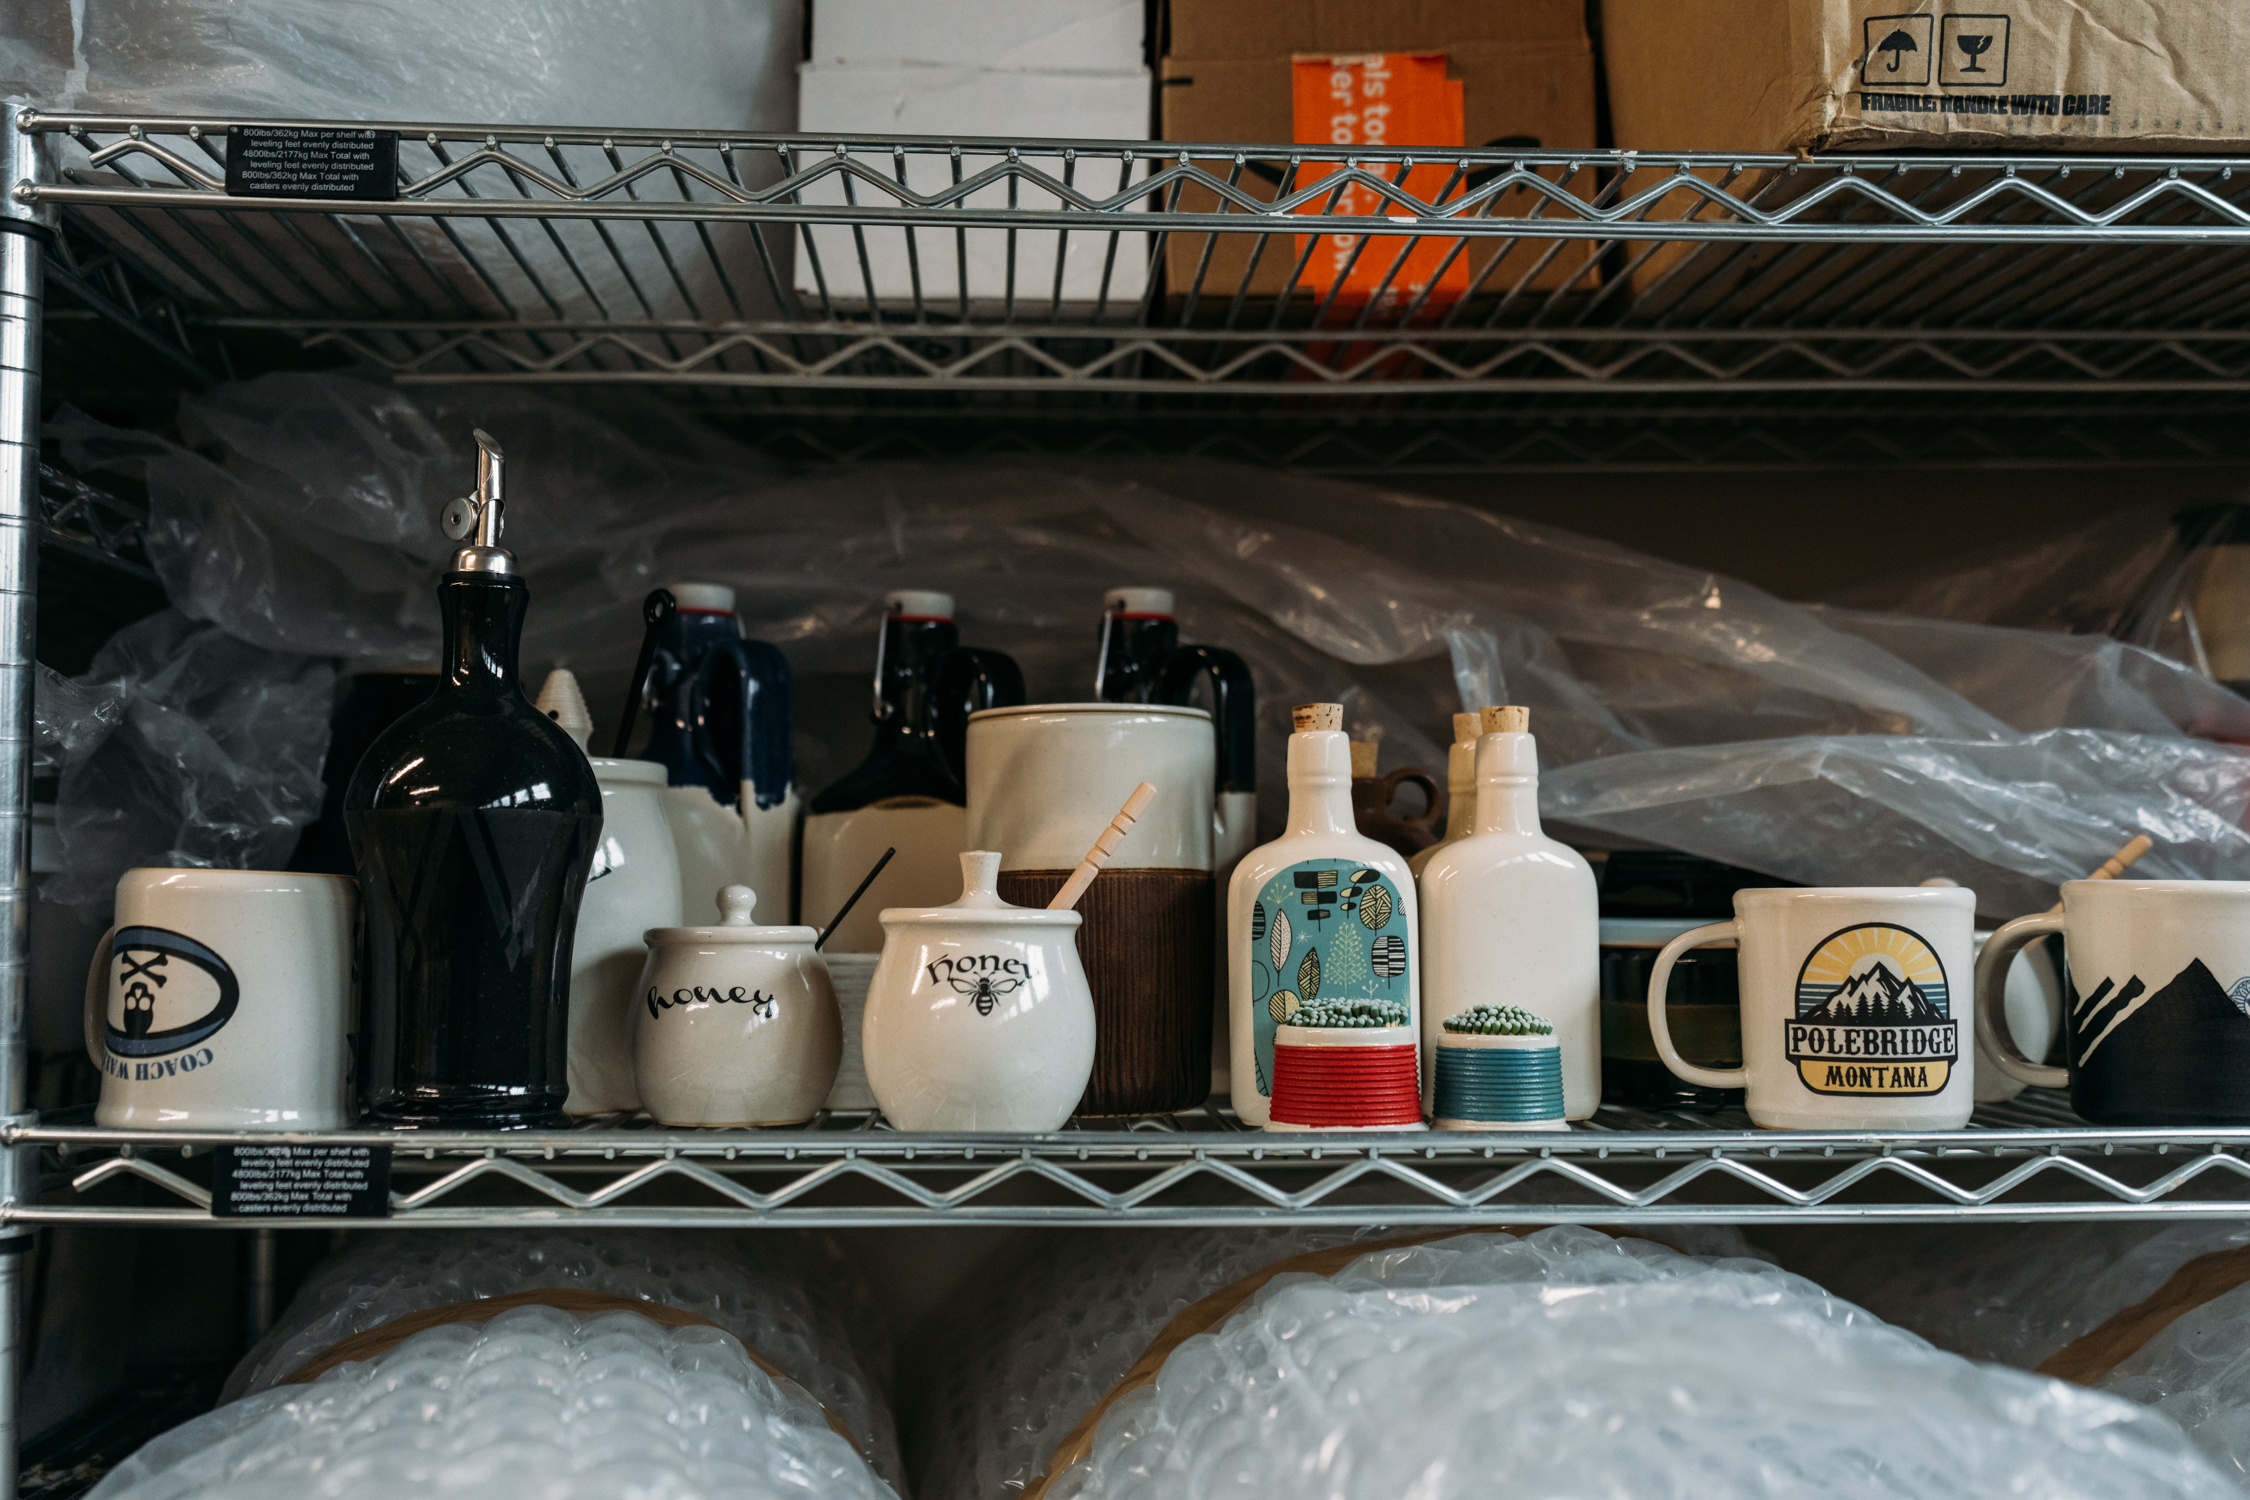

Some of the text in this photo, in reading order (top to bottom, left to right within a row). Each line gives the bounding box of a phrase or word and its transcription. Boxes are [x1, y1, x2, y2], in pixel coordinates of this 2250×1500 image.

[2011, 95, 2060, 115] WITH
[2062, 94, 2112, 116] CARE
[244, 128, 298, 138] 800lbs/362kg
[301, 130, 318, 138] Max
[251, 140, 374, 150] leveling feet evenly distributed
[243, 150, 308, 160] 4800lbs/2177kg
[353, 152, 370, 160] with
[250, 161, 374, 170] leveling feet evenly distributed
[242, 171, 359, 181] 800lbs/362kg Max Total with
[250, 182, 354, 192] casters evenly distributed
[648, 985, 774, 1019] honey
[1791, 1026, 1954, 1056] POLEBRIDGE
[135, 1047, 214, 1081] COACH
[1824, 1065, 1929, 1089] MONTANA
[293, 1148, 311, 1156] Max
[313, 1149, 328, 1158] per
[330, 1147, 351, 1156] shelf
[352, 1148, 370, 1156] with
[241, 1158, 370, 1169] leveling feet evenly distributed
[232, 1169, 364, 1180] 4800lbs/2177kg Max Total with
[240, 1181, 368, 1191] leveling feet evenly distributed
[231, 1192, 352, 1202] 800lbs/362kg Max Total with
[238, 1204, 347, 1214] casters evenly distributed
